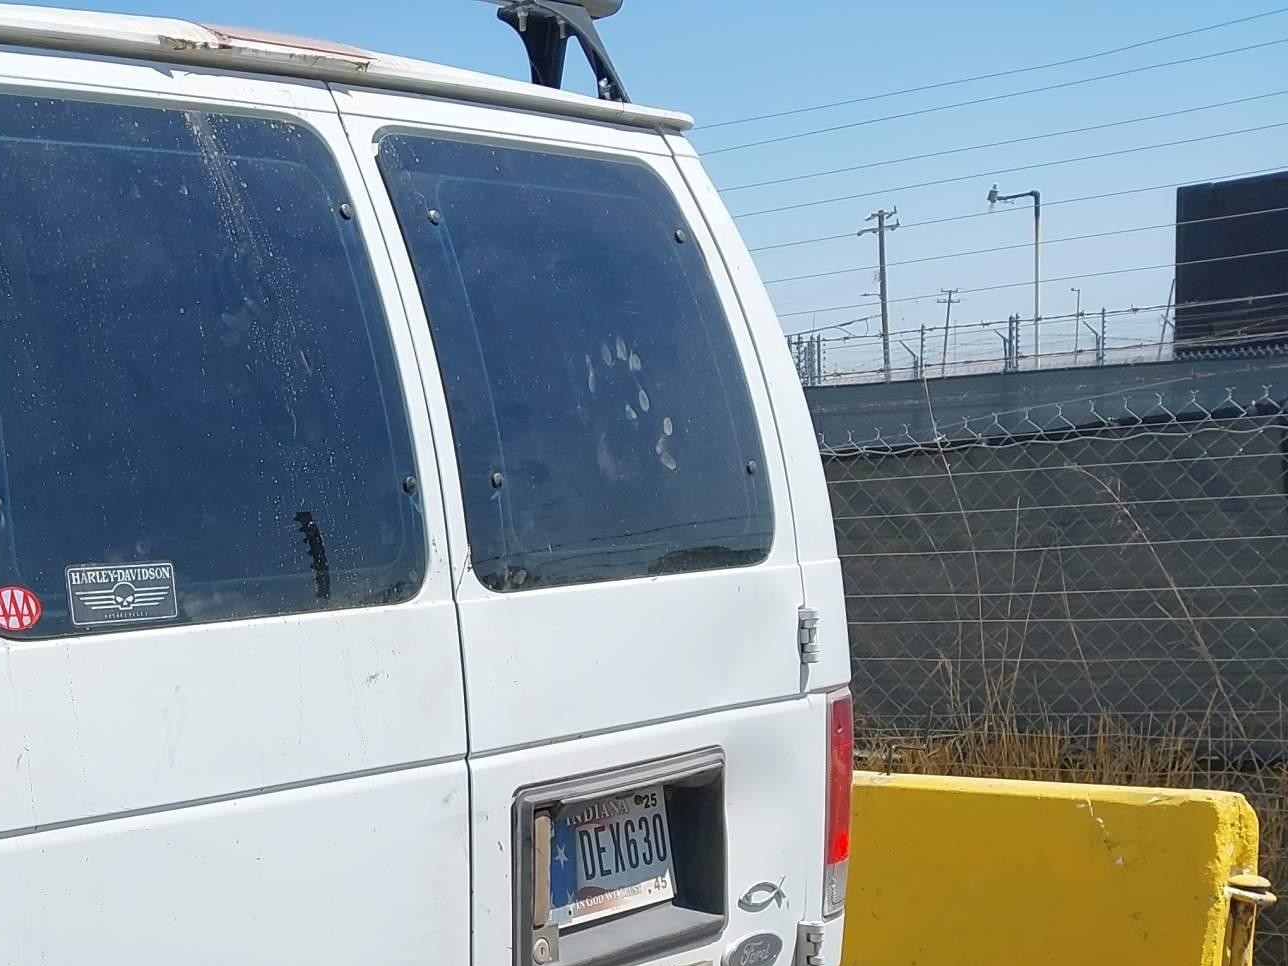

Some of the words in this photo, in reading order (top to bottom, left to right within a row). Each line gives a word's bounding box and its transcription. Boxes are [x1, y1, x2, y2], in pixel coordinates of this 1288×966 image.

[71, 567, 171, 585] HARLEY-DAVIDSON
[566, 799, 629, 827] INDIANA
[578, 813, 668, 881] DEX630
[653, 875, 668, 891] 45
[585, 893, 605, 907] GOD
[739, 940, 772, 966] Ford
